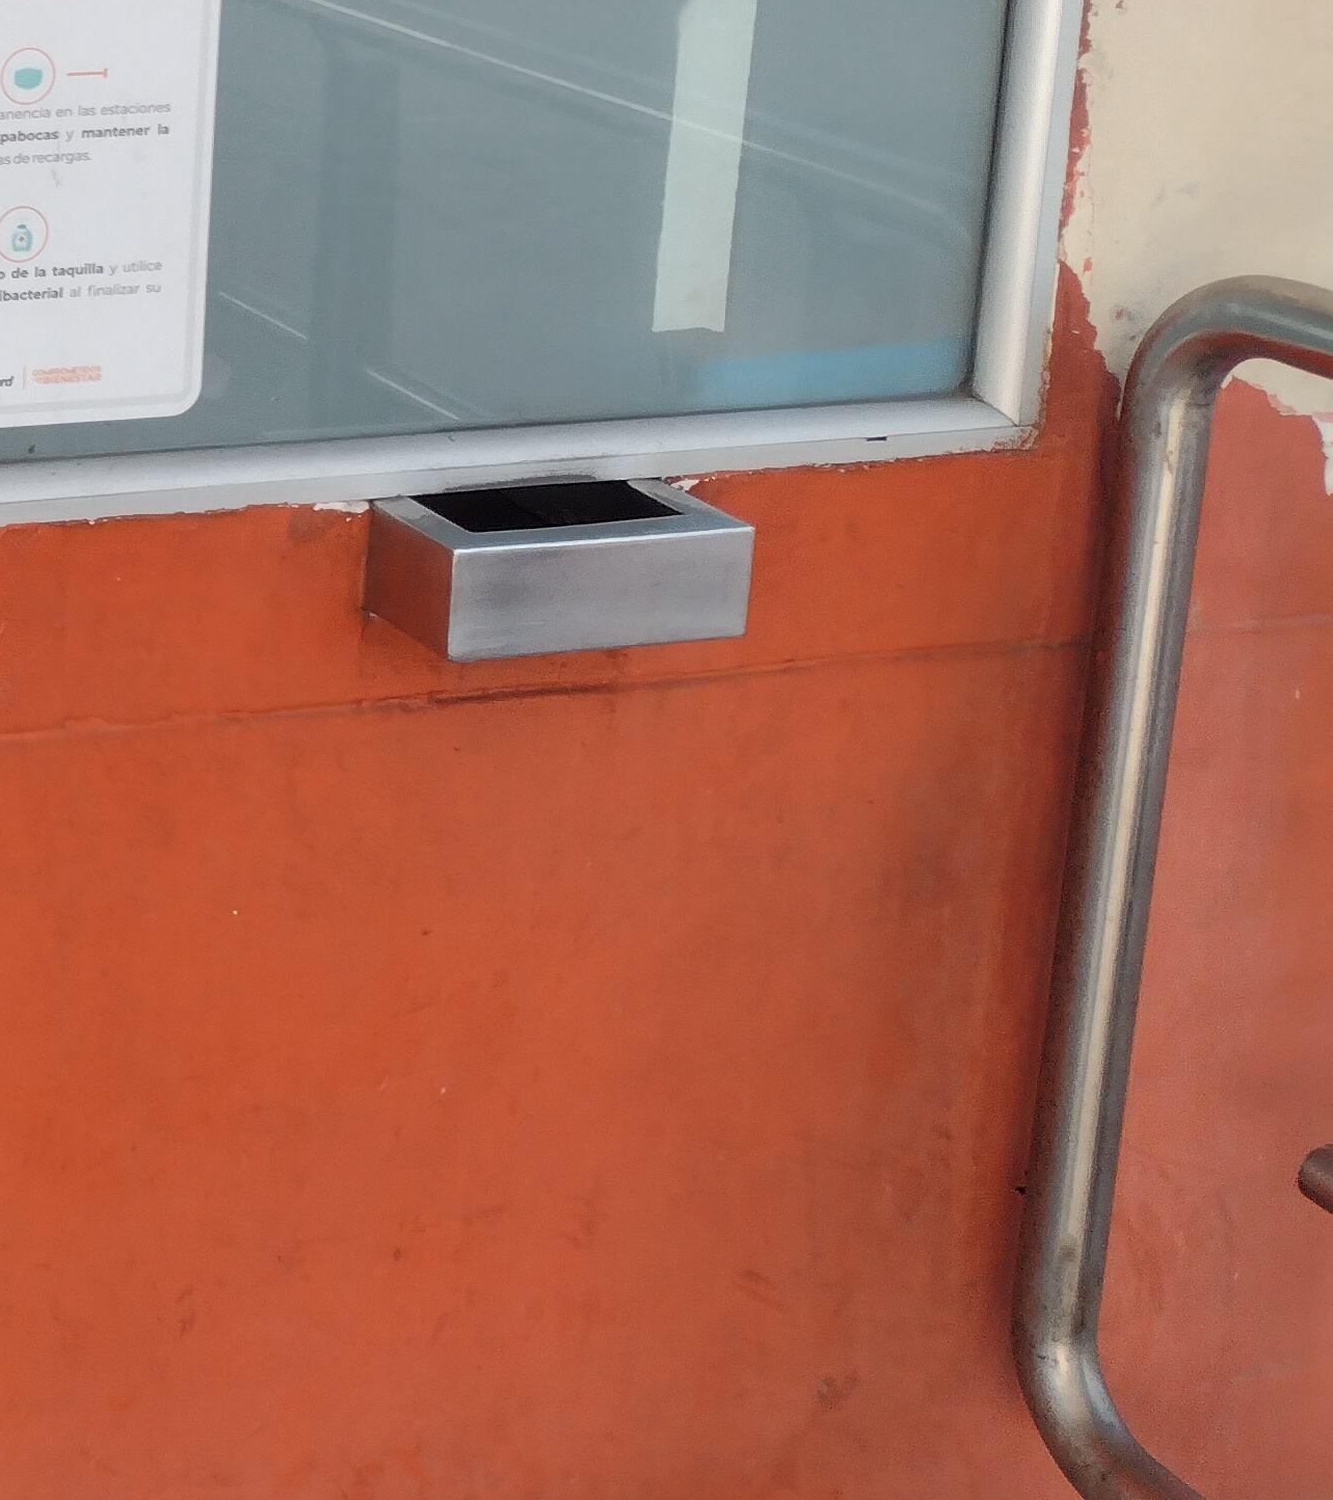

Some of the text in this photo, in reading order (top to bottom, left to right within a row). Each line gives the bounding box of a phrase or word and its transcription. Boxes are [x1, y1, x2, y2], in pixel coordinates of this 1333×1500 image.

[55, 108, 73, 118] en
[78, 105, 96, 116] las
[100, 102, 171, 115] estaciones
[65, 130, 75, 143] y
[81, 125, 150, 139] mantener
[157, 123, 170, 135] la
[13, 153, 30, 165] de
[32, 151, 92, 165] recargas.
[11, 267, 29, 279] de
[34, 266, 47, 278] la
[52, 263, 104, 278] taquilla
[108, 264, 118, 276] y
[122, 260, 163, 273] utilice
[69, 287, 81, 298] al
[87, 284, 140, 297] finalizar
[146, 283, 162, 294] su
